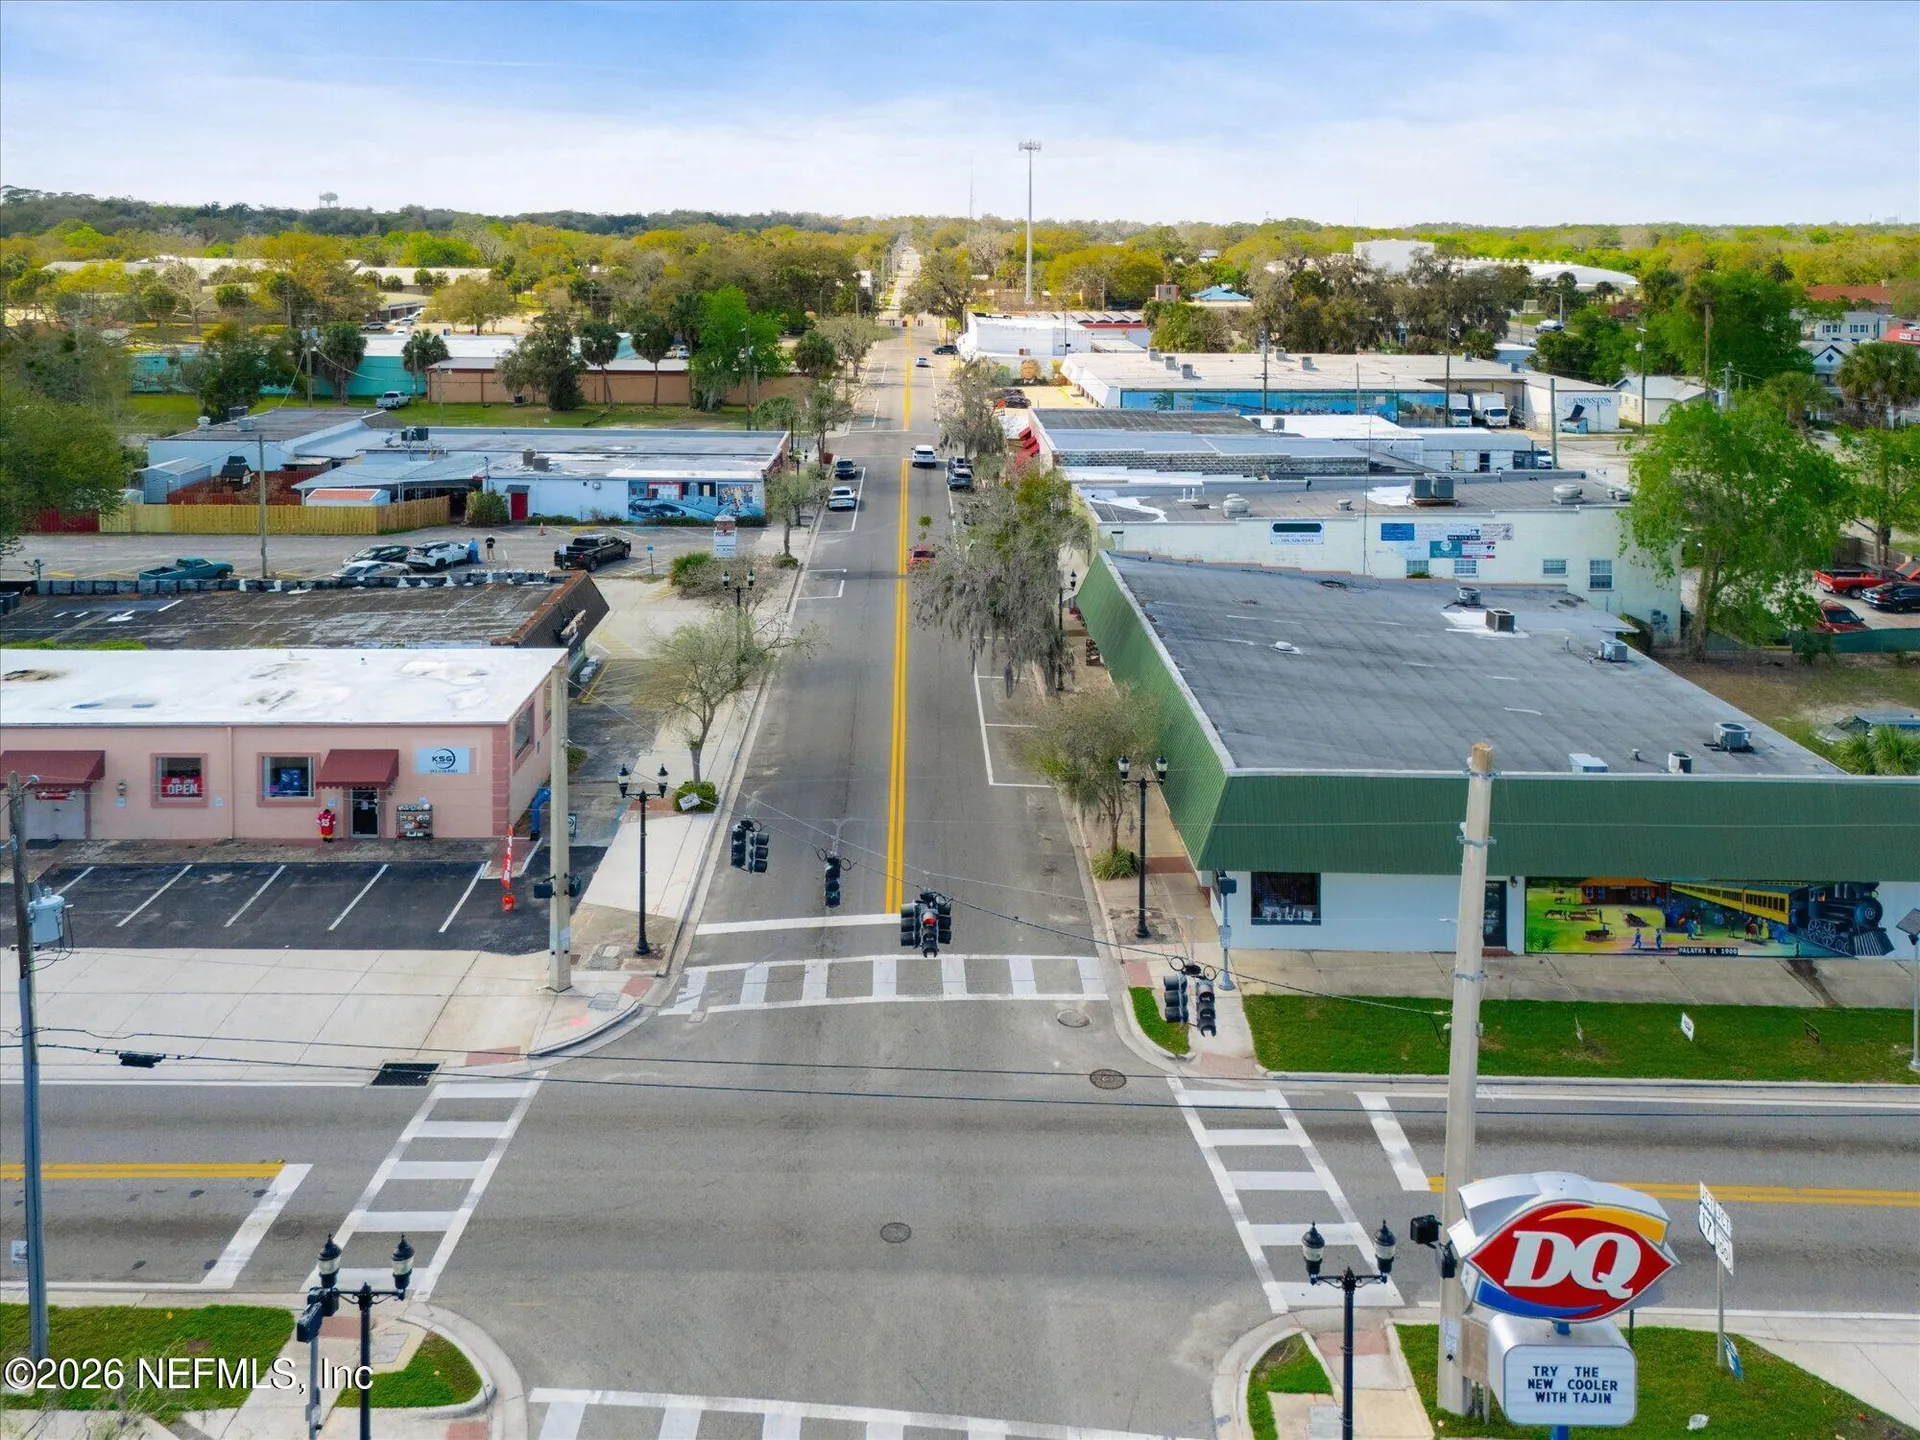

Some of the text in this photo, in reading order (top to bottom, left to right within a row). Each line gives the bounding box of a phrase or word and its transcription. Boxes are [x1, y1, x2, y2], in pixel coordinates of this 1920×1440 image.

[168, 784, 198, 795] OPEN
[1702, 1212, 1712, 1235] 17
[1504, 1231, 1641, 1299] DQ
[1533, 1366, 1599, 1377] TRY THE
[1528, 1379, 1618, 1391] NEW COOLER
[1535, 1392, 1612, 1404] WITH TAJIN
